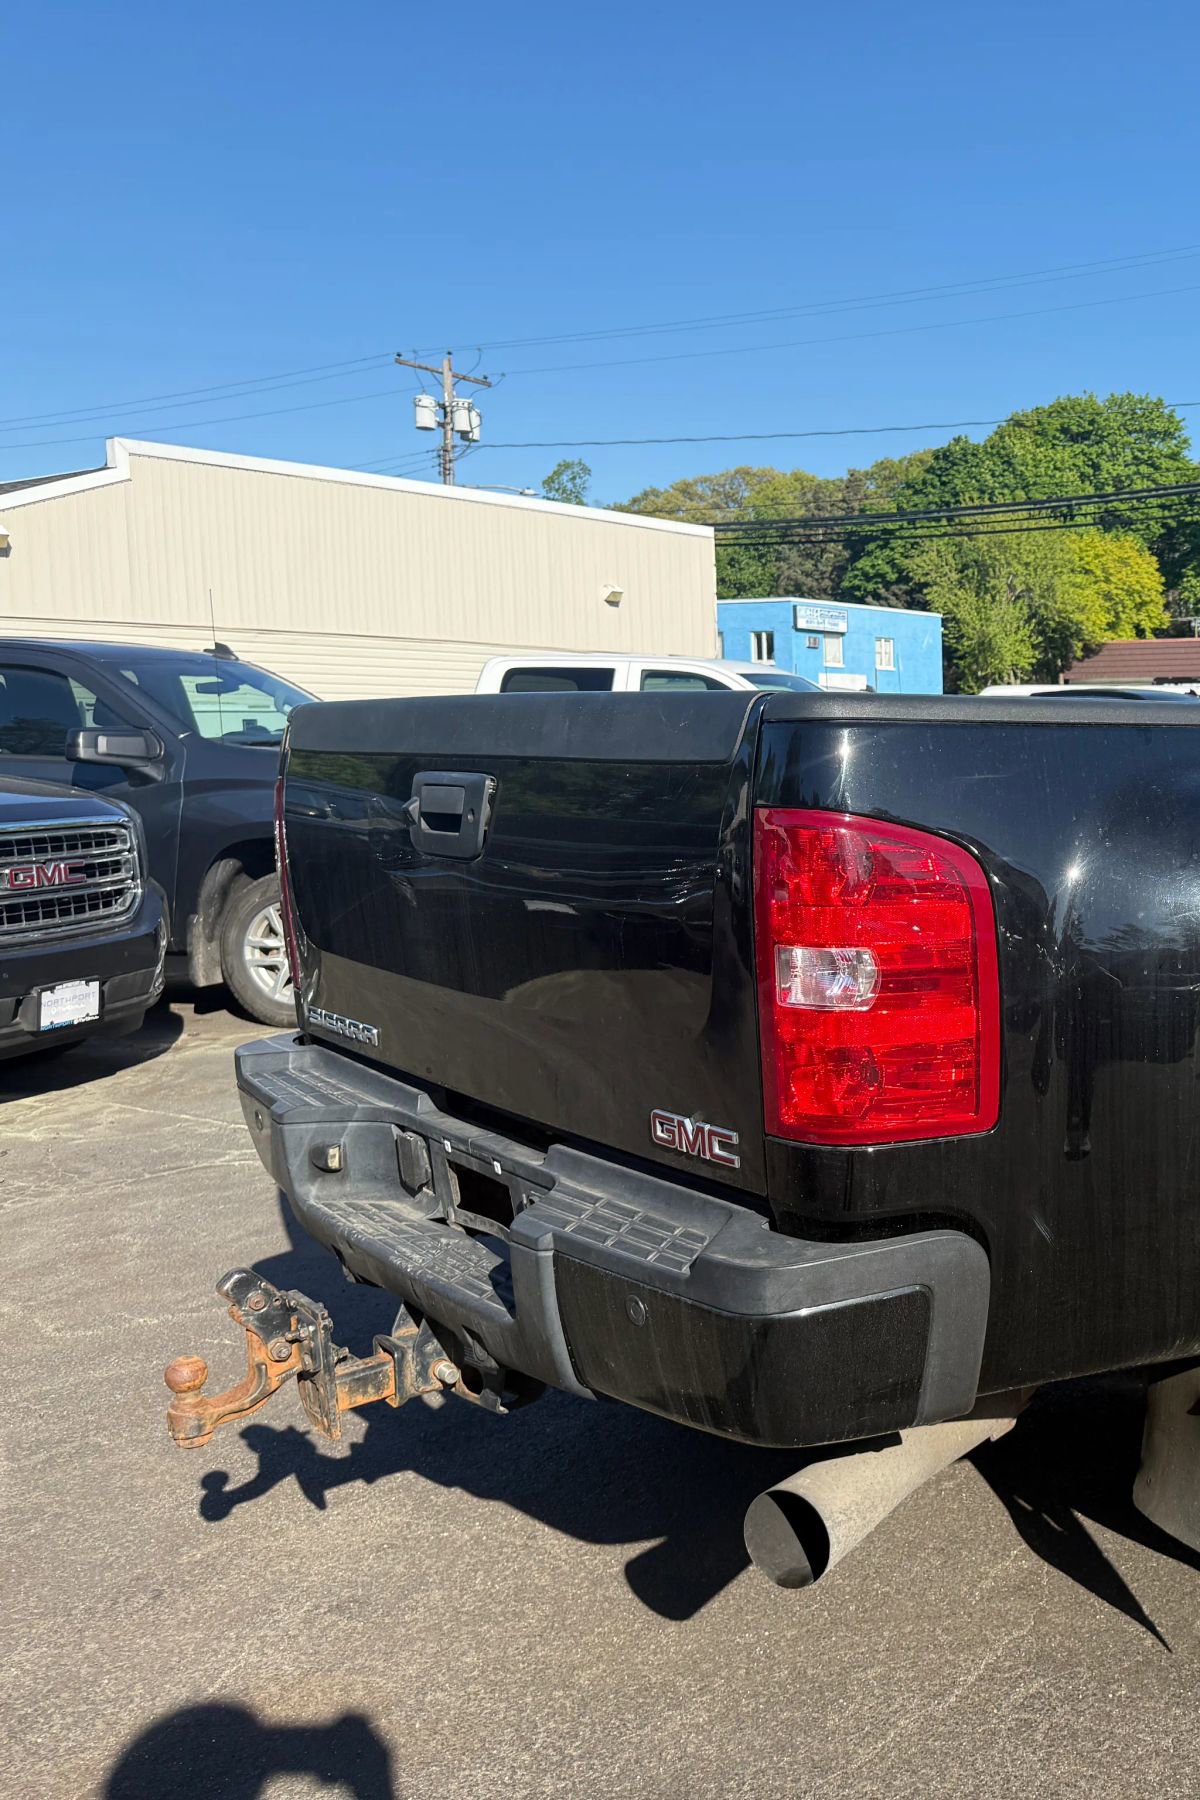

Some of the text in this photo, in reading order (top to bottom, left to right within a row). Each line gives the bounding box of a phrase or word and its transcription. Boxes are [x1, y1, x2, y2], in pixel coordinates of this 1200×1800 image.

[8, 859, 87, 890] GMC
[308, 1005, 379, 1047] SIERRA
[650, 1108, 740, 1169] GMC
